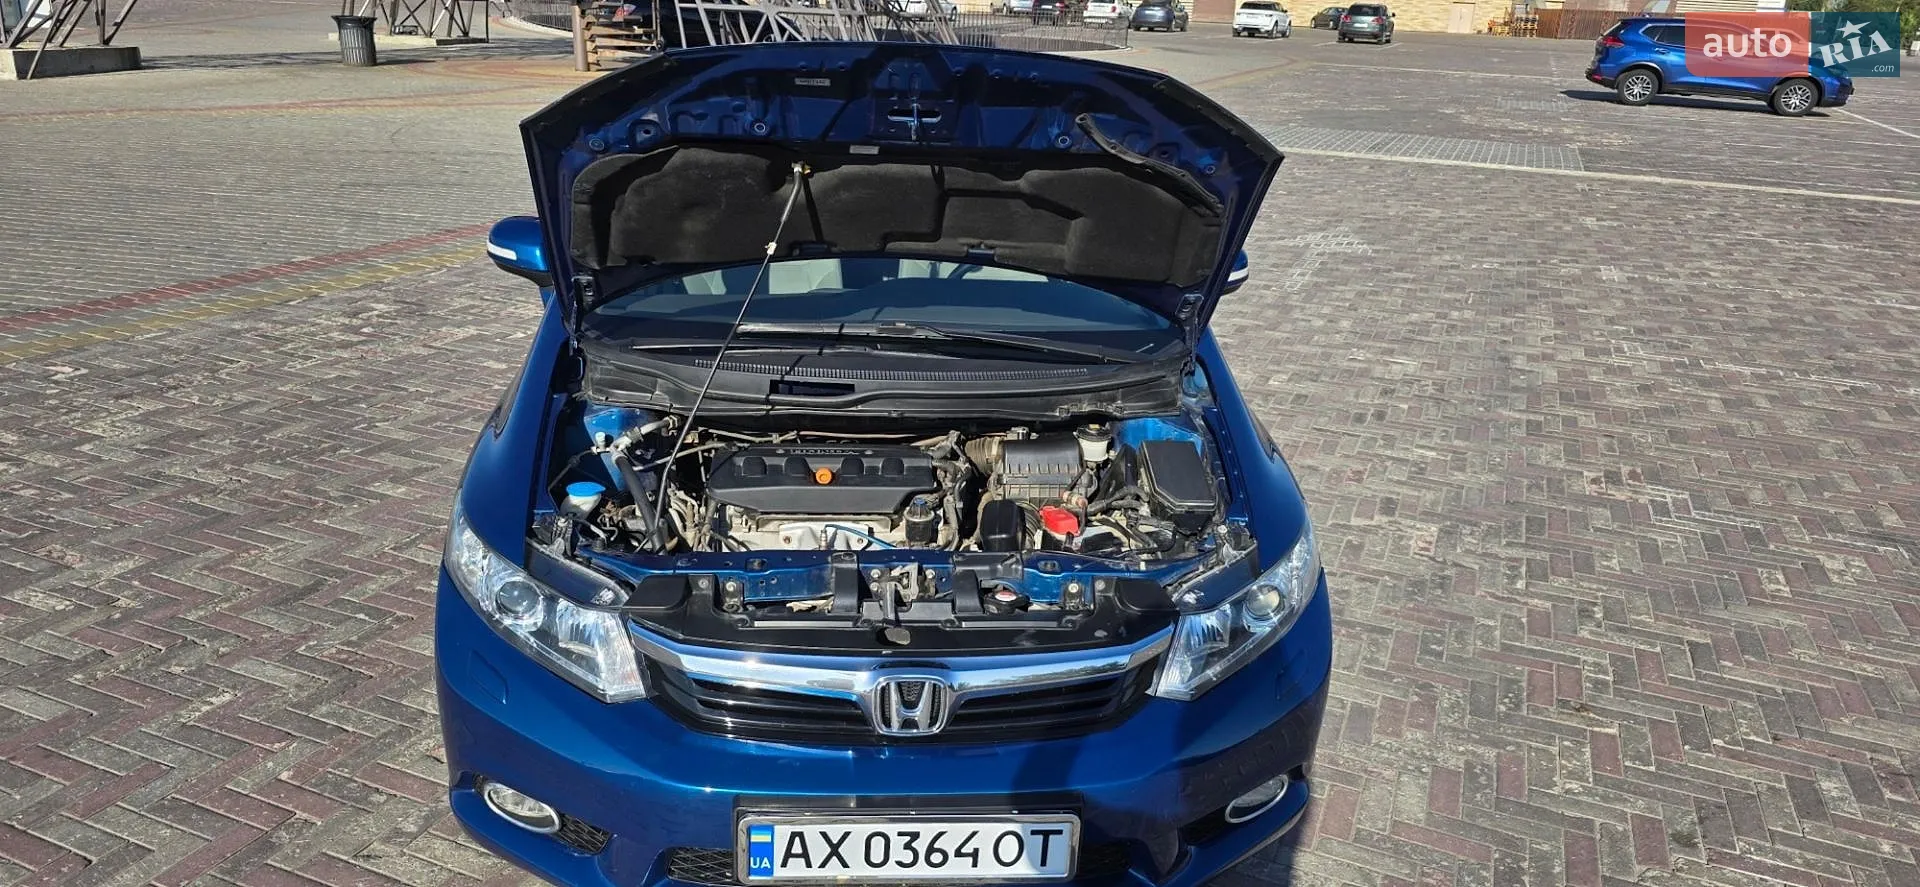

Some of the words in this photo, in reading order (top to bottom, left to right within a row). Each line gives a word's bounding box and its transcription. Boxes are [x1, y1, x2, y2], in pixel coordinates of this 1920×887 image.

[780, 831, 851, 869] AX
[864, 831, 979, 869] 0364
[993, 829, 1063, 868] OT
[750, 856, 771, 869] UA
